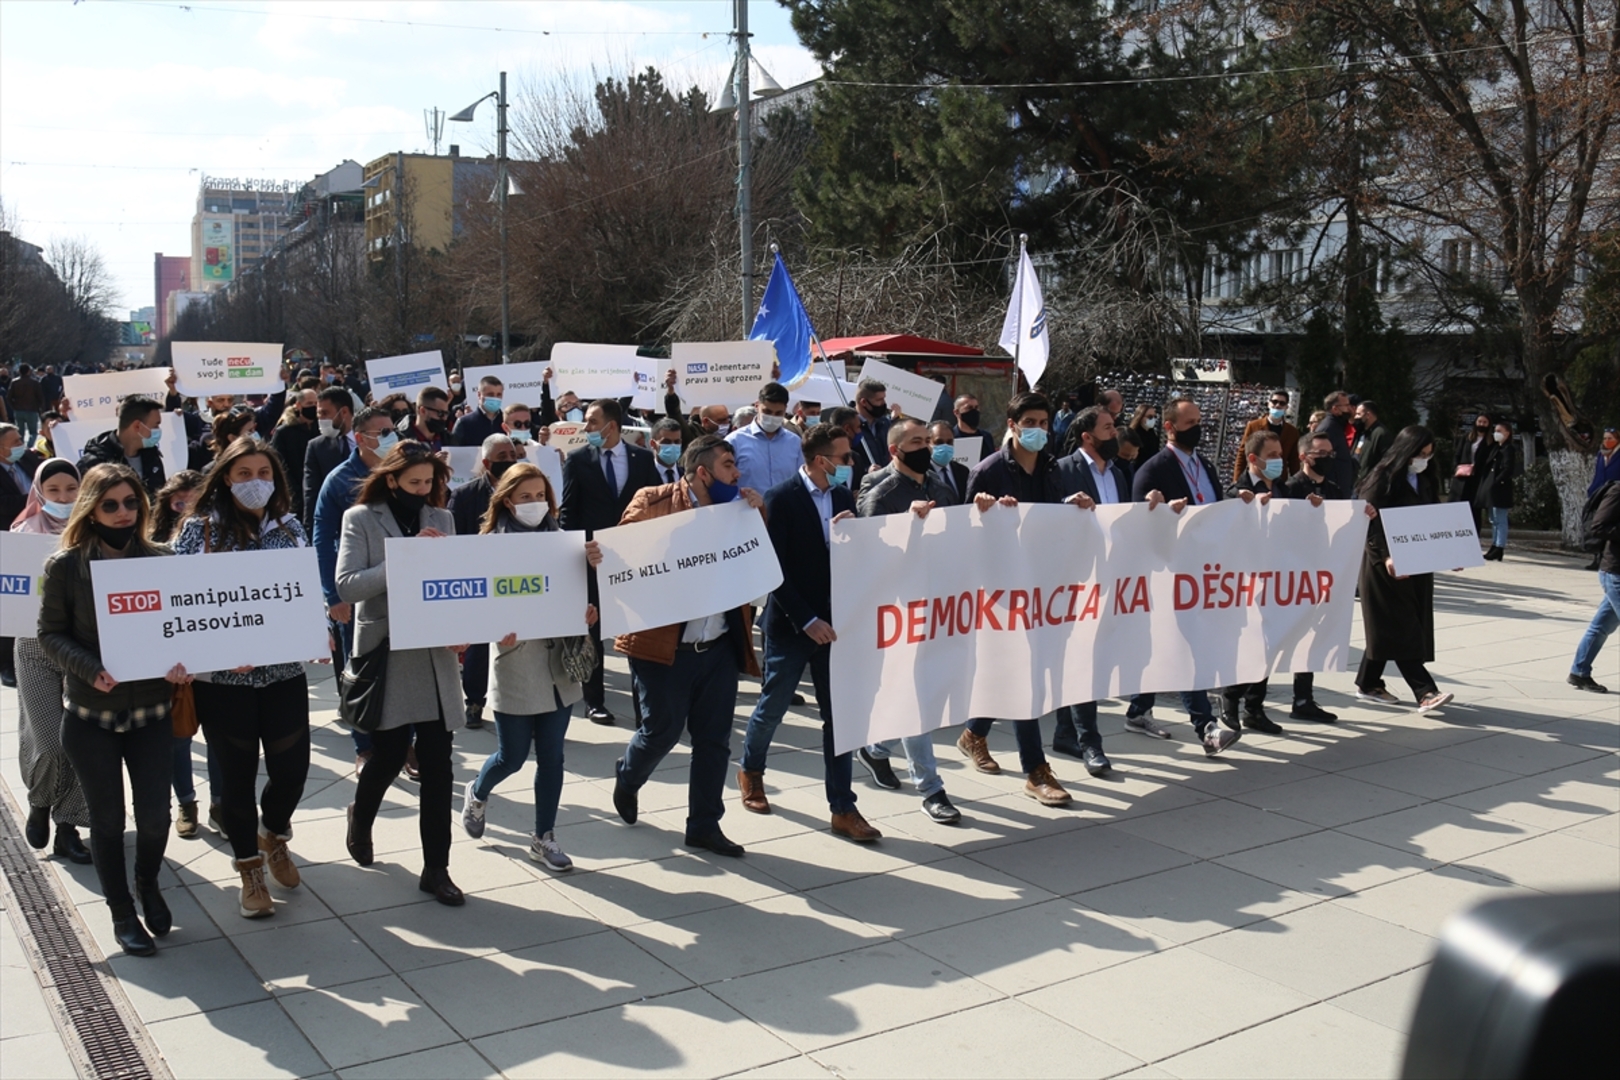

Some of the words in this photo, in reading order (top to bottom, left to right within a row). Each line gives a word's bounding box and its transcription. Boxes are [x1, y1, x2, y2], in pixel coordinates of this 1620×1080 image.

[197, 369, 224, 380] svoje
[710, 363, 761, 372] elementarna
[685, 376, 708, 386] prava
[77, 398, 94, 408] PSE
[99, 396, 111, 405] PO
[1392, 534, 1409, 544] THIS
[1411, 533, 1427, 542] WILL
[1429, 531, 1453, 540] HAPPEN
[1455, 528, 1473, 538] AGAIN
[608, 570, 634, 586] THIS
[639, 562, 671, 578] WILL
[677, 552, 718, 570] HAPPEN
[722, 537, 760, 562] AGAIN
[110, 592, 159, 613] STOP
[170, 581, 304, 608] manipulaciji
[425, 581, 485, 600] DIGNI
[496, 576, 550, 596] GLAS!
[876, 582, 1100, 650] DEMOKRACIA
[1113, 575, 1151, 616] KA
[1172, 563, 1334, 612] DËSHTUAR
[162, 611, 265, 639] glasovima
